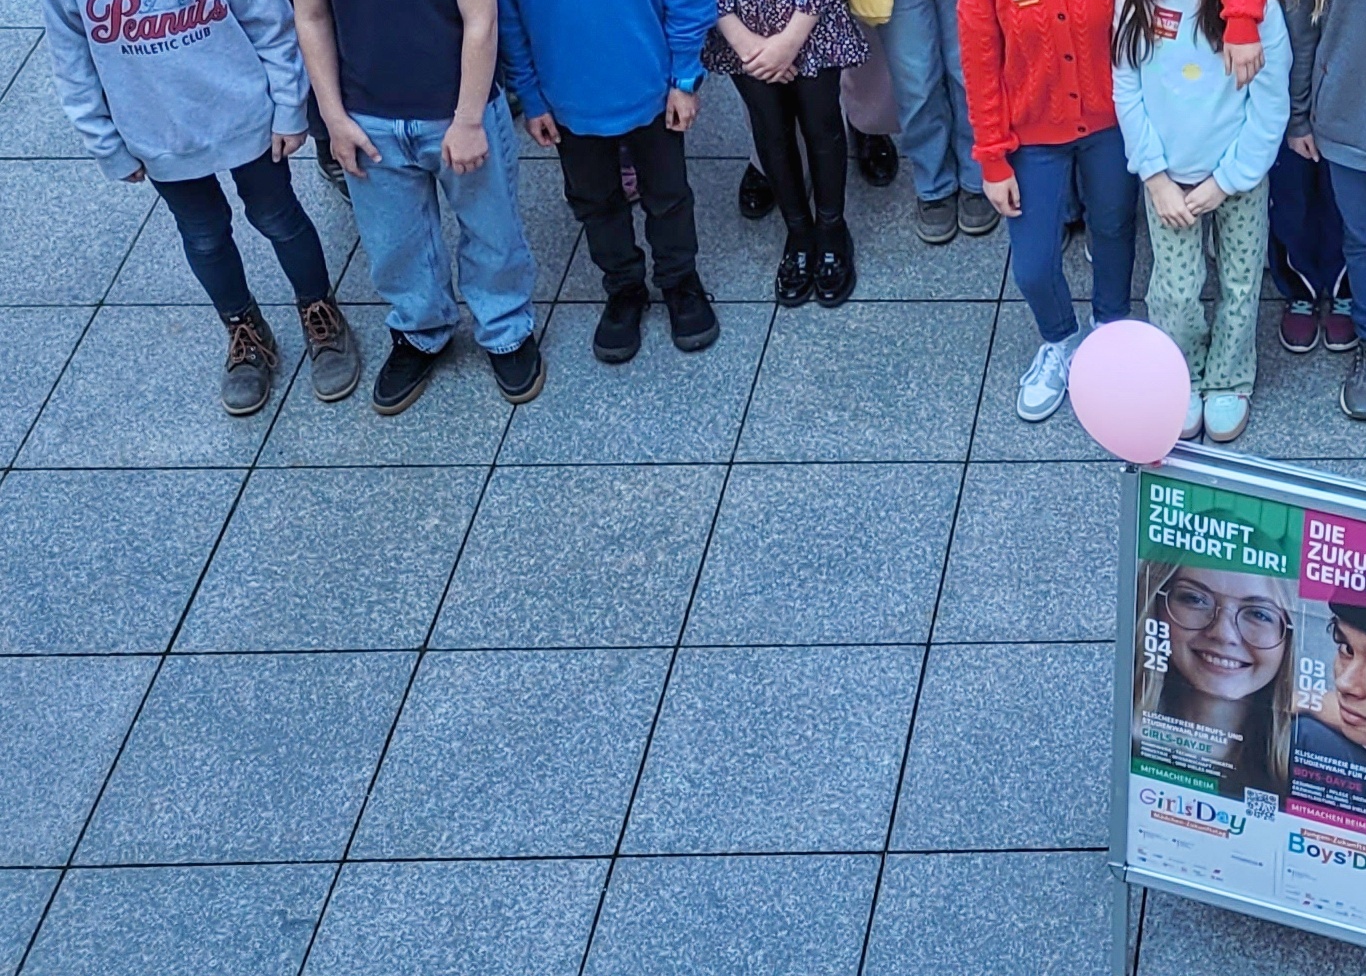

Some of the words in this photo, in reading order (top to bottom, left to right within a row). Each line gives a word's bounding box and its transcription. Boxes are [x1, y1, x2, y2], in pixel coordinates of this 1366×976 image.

[121, 39, 179, 55] ATHLETIC
[182, 26, 211, 47] CLUB
[1150, 483, 1185, 508] DIE
[1149, 504, 1254, 544] ZUKUNFT
[1309, 519, 1346, 546] DIE
[1148, 524, 1236, 561] GEHÖRT
[1243, 546, 1287, 573] DIR!
[1144, 618, 1170, 639] 03
[1144, 636, 1172, 657] 04
[1143, 652, 1168, 673] 25
[1300, 657, 1326, 678] 03
[1299, 675, 1327, 696] 04
[1296, 691, 1323, 712] 25
[1142, 727, 1212, 753] GIRLS-DAY.DE
[1210, 734, 1228, 744] ALLE
[1228, 731, 1244, 741] UND
[1294, 749, 1349, 767] KLISCHEEFREIE
[1294, 756, 1347, 775] STUDIENWAHL
[1140, 764, 1192, 783] MITMACHEN
[1192, 778, 1215, 790] BEIM
[1291, 803, 1344, 823] MITMACHEN
[1345, 817, 1366, 829] BEIM
